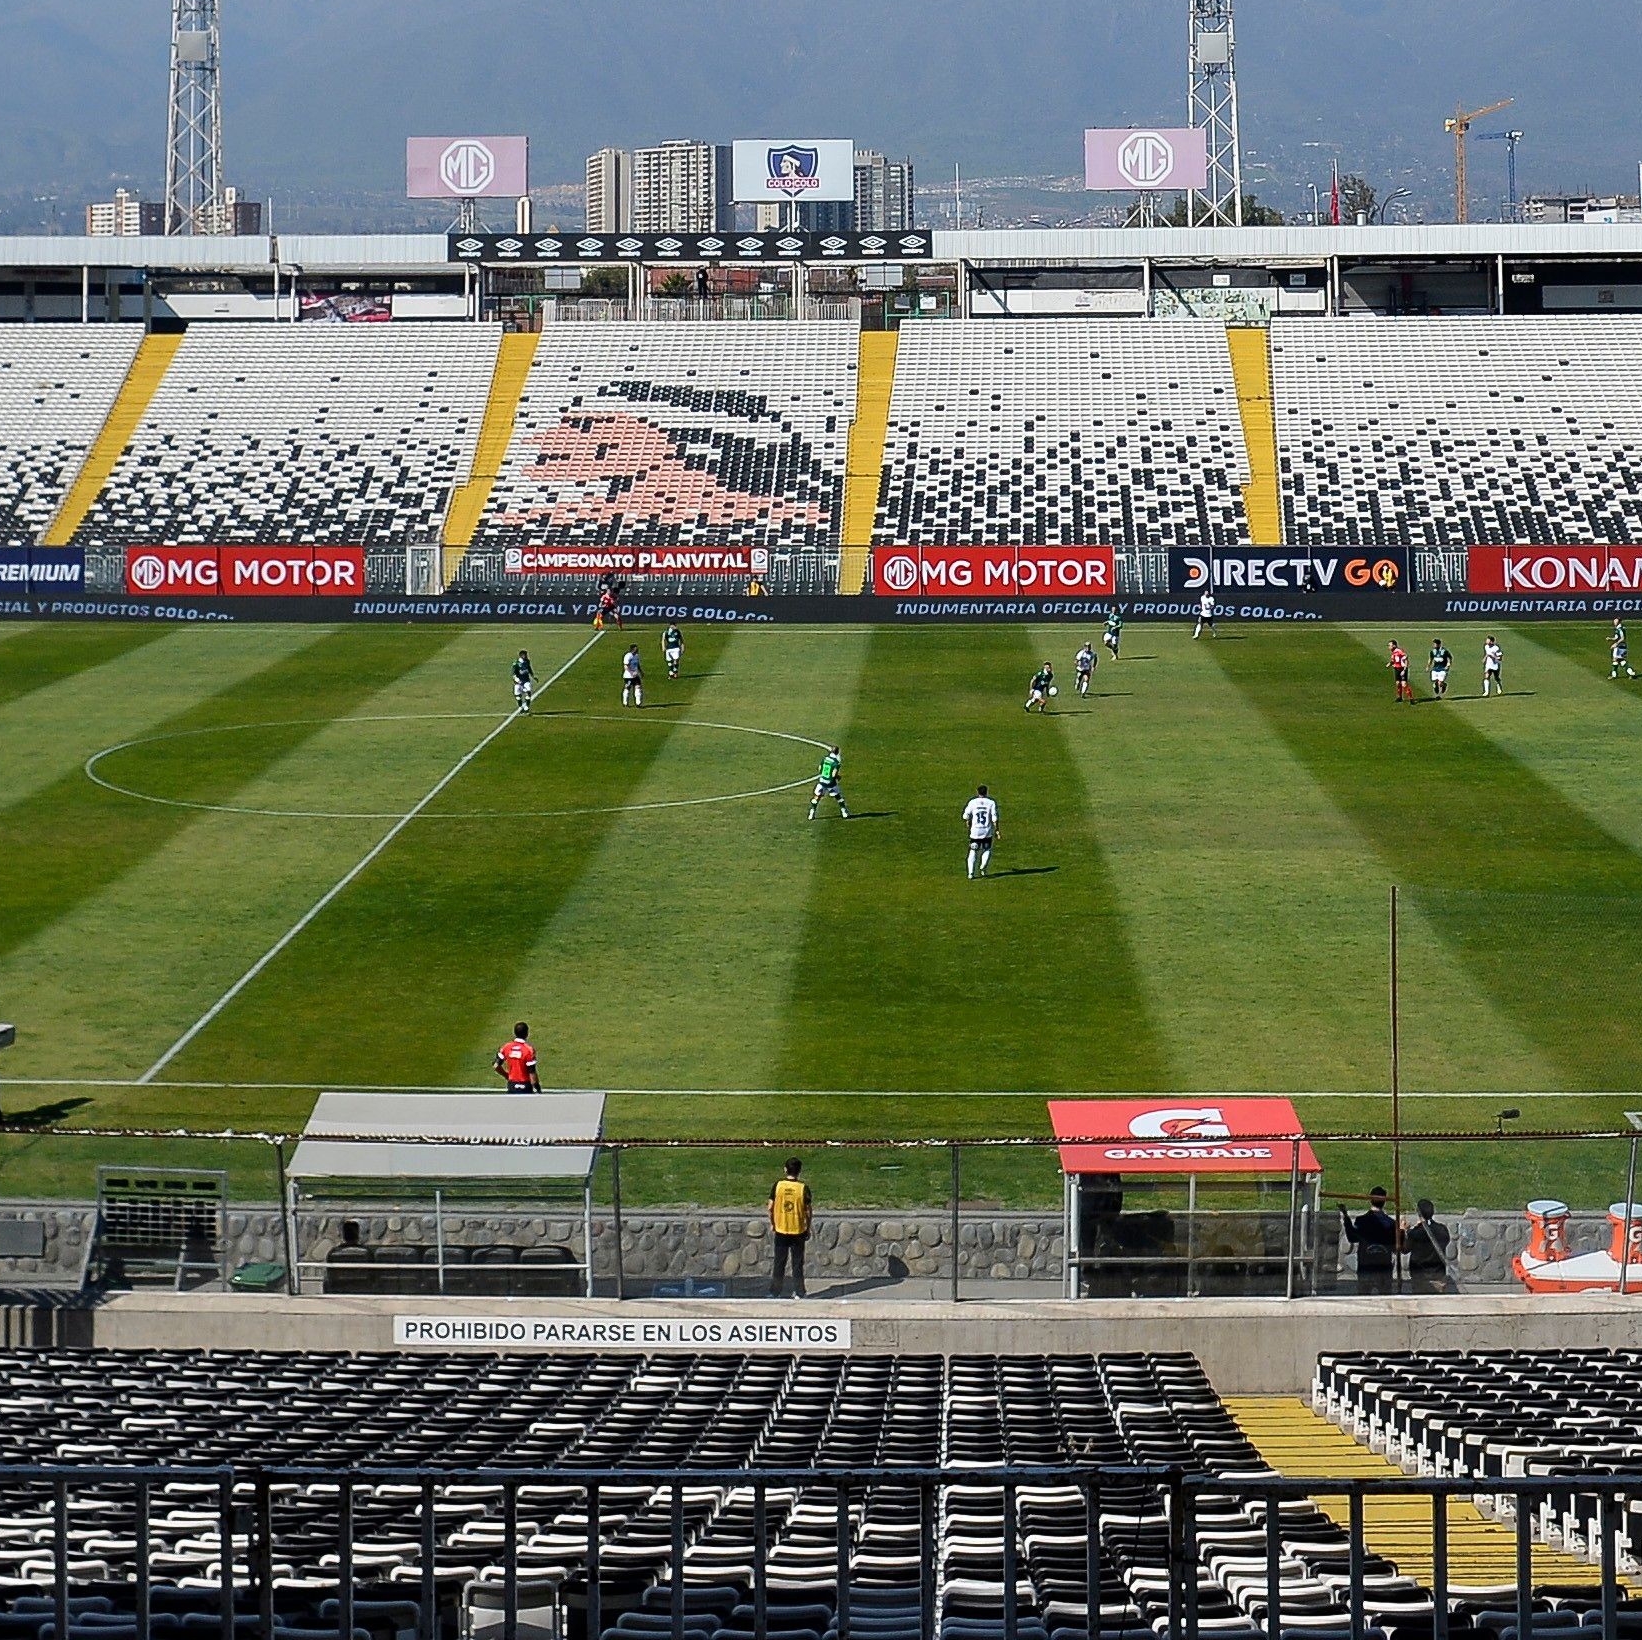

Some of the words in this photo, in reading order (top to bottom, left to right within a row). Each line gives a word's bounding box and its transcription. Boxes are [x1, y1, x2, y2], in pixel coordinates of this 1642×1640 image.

[447, 145, 489, 189] MG
[1125, 137, 1167, 181] MG
[522, 554, 635, 569] CAMPEONATO
[638, 551, 749, 569] PLANVITAL
[168, 560, 218, 585] MG
[234, 560, 355, 586] MOTOR
[922, 560, 972, 586] MG
[985, 560, 1106, 586] MOTOR
[1184, 558, 1338, 587] DIRECTV
[36, 601, 49, 613] Y
[353, 602, 493, 615] INDUMENTARIA
[497, 603, 565, 616] OFICIAL
[571, 604, 584, 616] Y
[587, 604, 688, 618] PDUCTOS
[896, 603, 1037, 615] INDUMENTARIA
[1042, 603, 1109, 615] OFICIAL
[1117, 603, 1127, 615] Y
[1133, 604, 1235, 617] PRODUCOS
[1445, 599, 1587, 612] INDUMENTARIA
[1128, 1107, 1233, 1147] G
[1104, 1147, 1273, 1160] GATORADE
[405, 1322, 526, 1340] PROHIBIDO
[533, 1323, 635, 1341] PARARSE
[643, 1324, 671, 1342] EN
[680, 1324, 725, 1343] LOS
[728, 1324, 837, 1343] ASIENTOS
